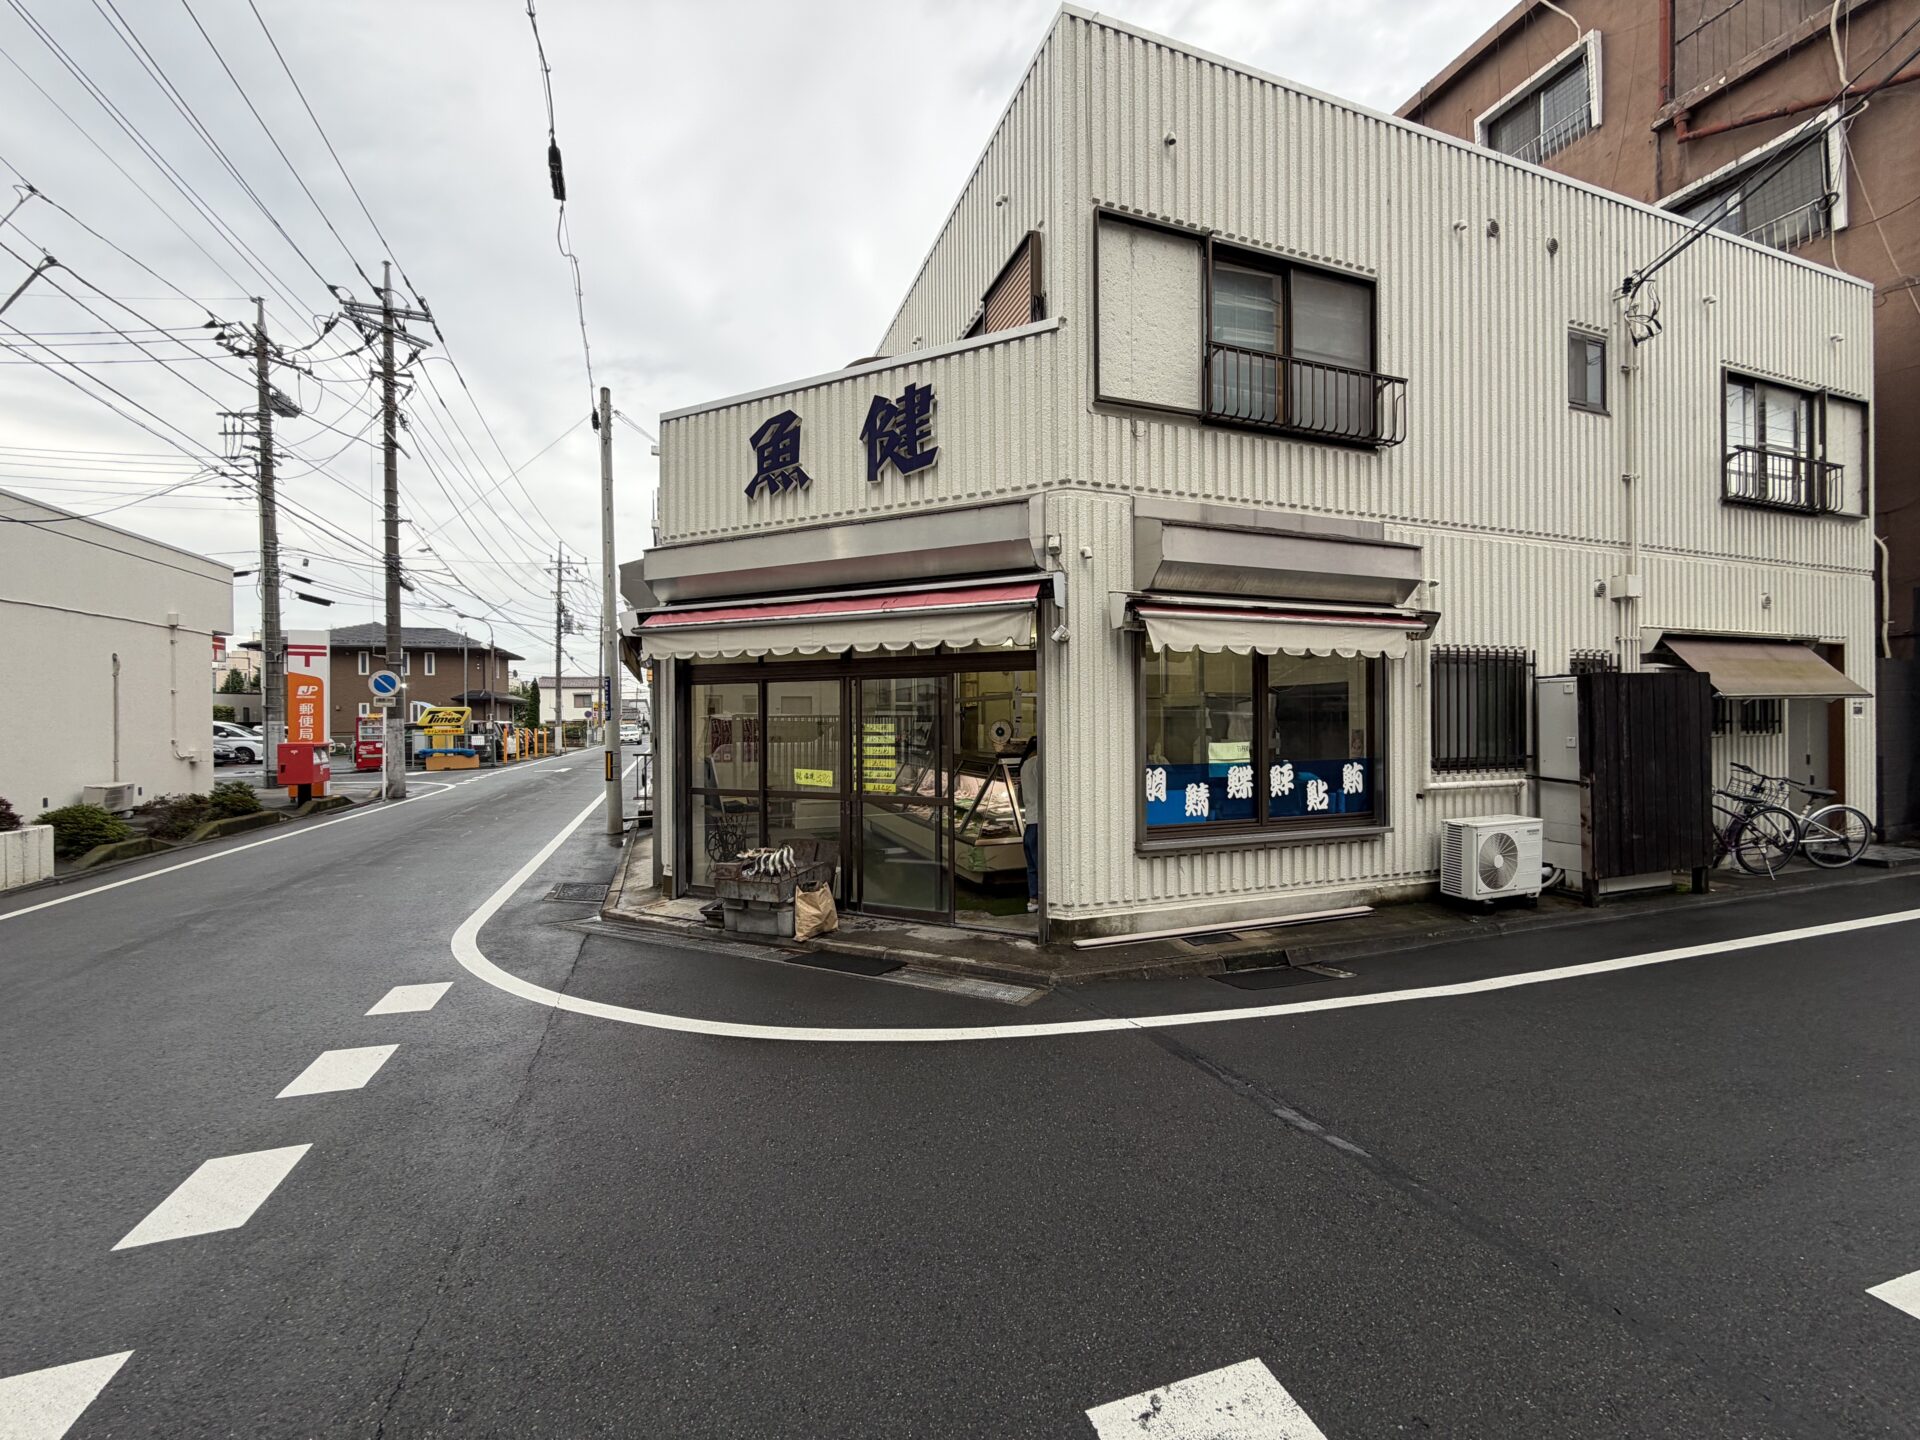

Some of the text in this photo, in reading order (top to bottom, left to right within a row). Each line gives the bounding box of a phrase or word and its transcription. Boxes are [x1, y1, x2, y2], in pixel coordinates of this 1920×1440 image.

[744, 382, 941, 500] 魚健
[297, 685, 319, 695] JP
[298, 703, 314, 740] 郵便局
[428, 714, 462, 724] Times
[1185, 782, 1210, 818] 鯖
[1342, 761, 1364, 795] 鮪
